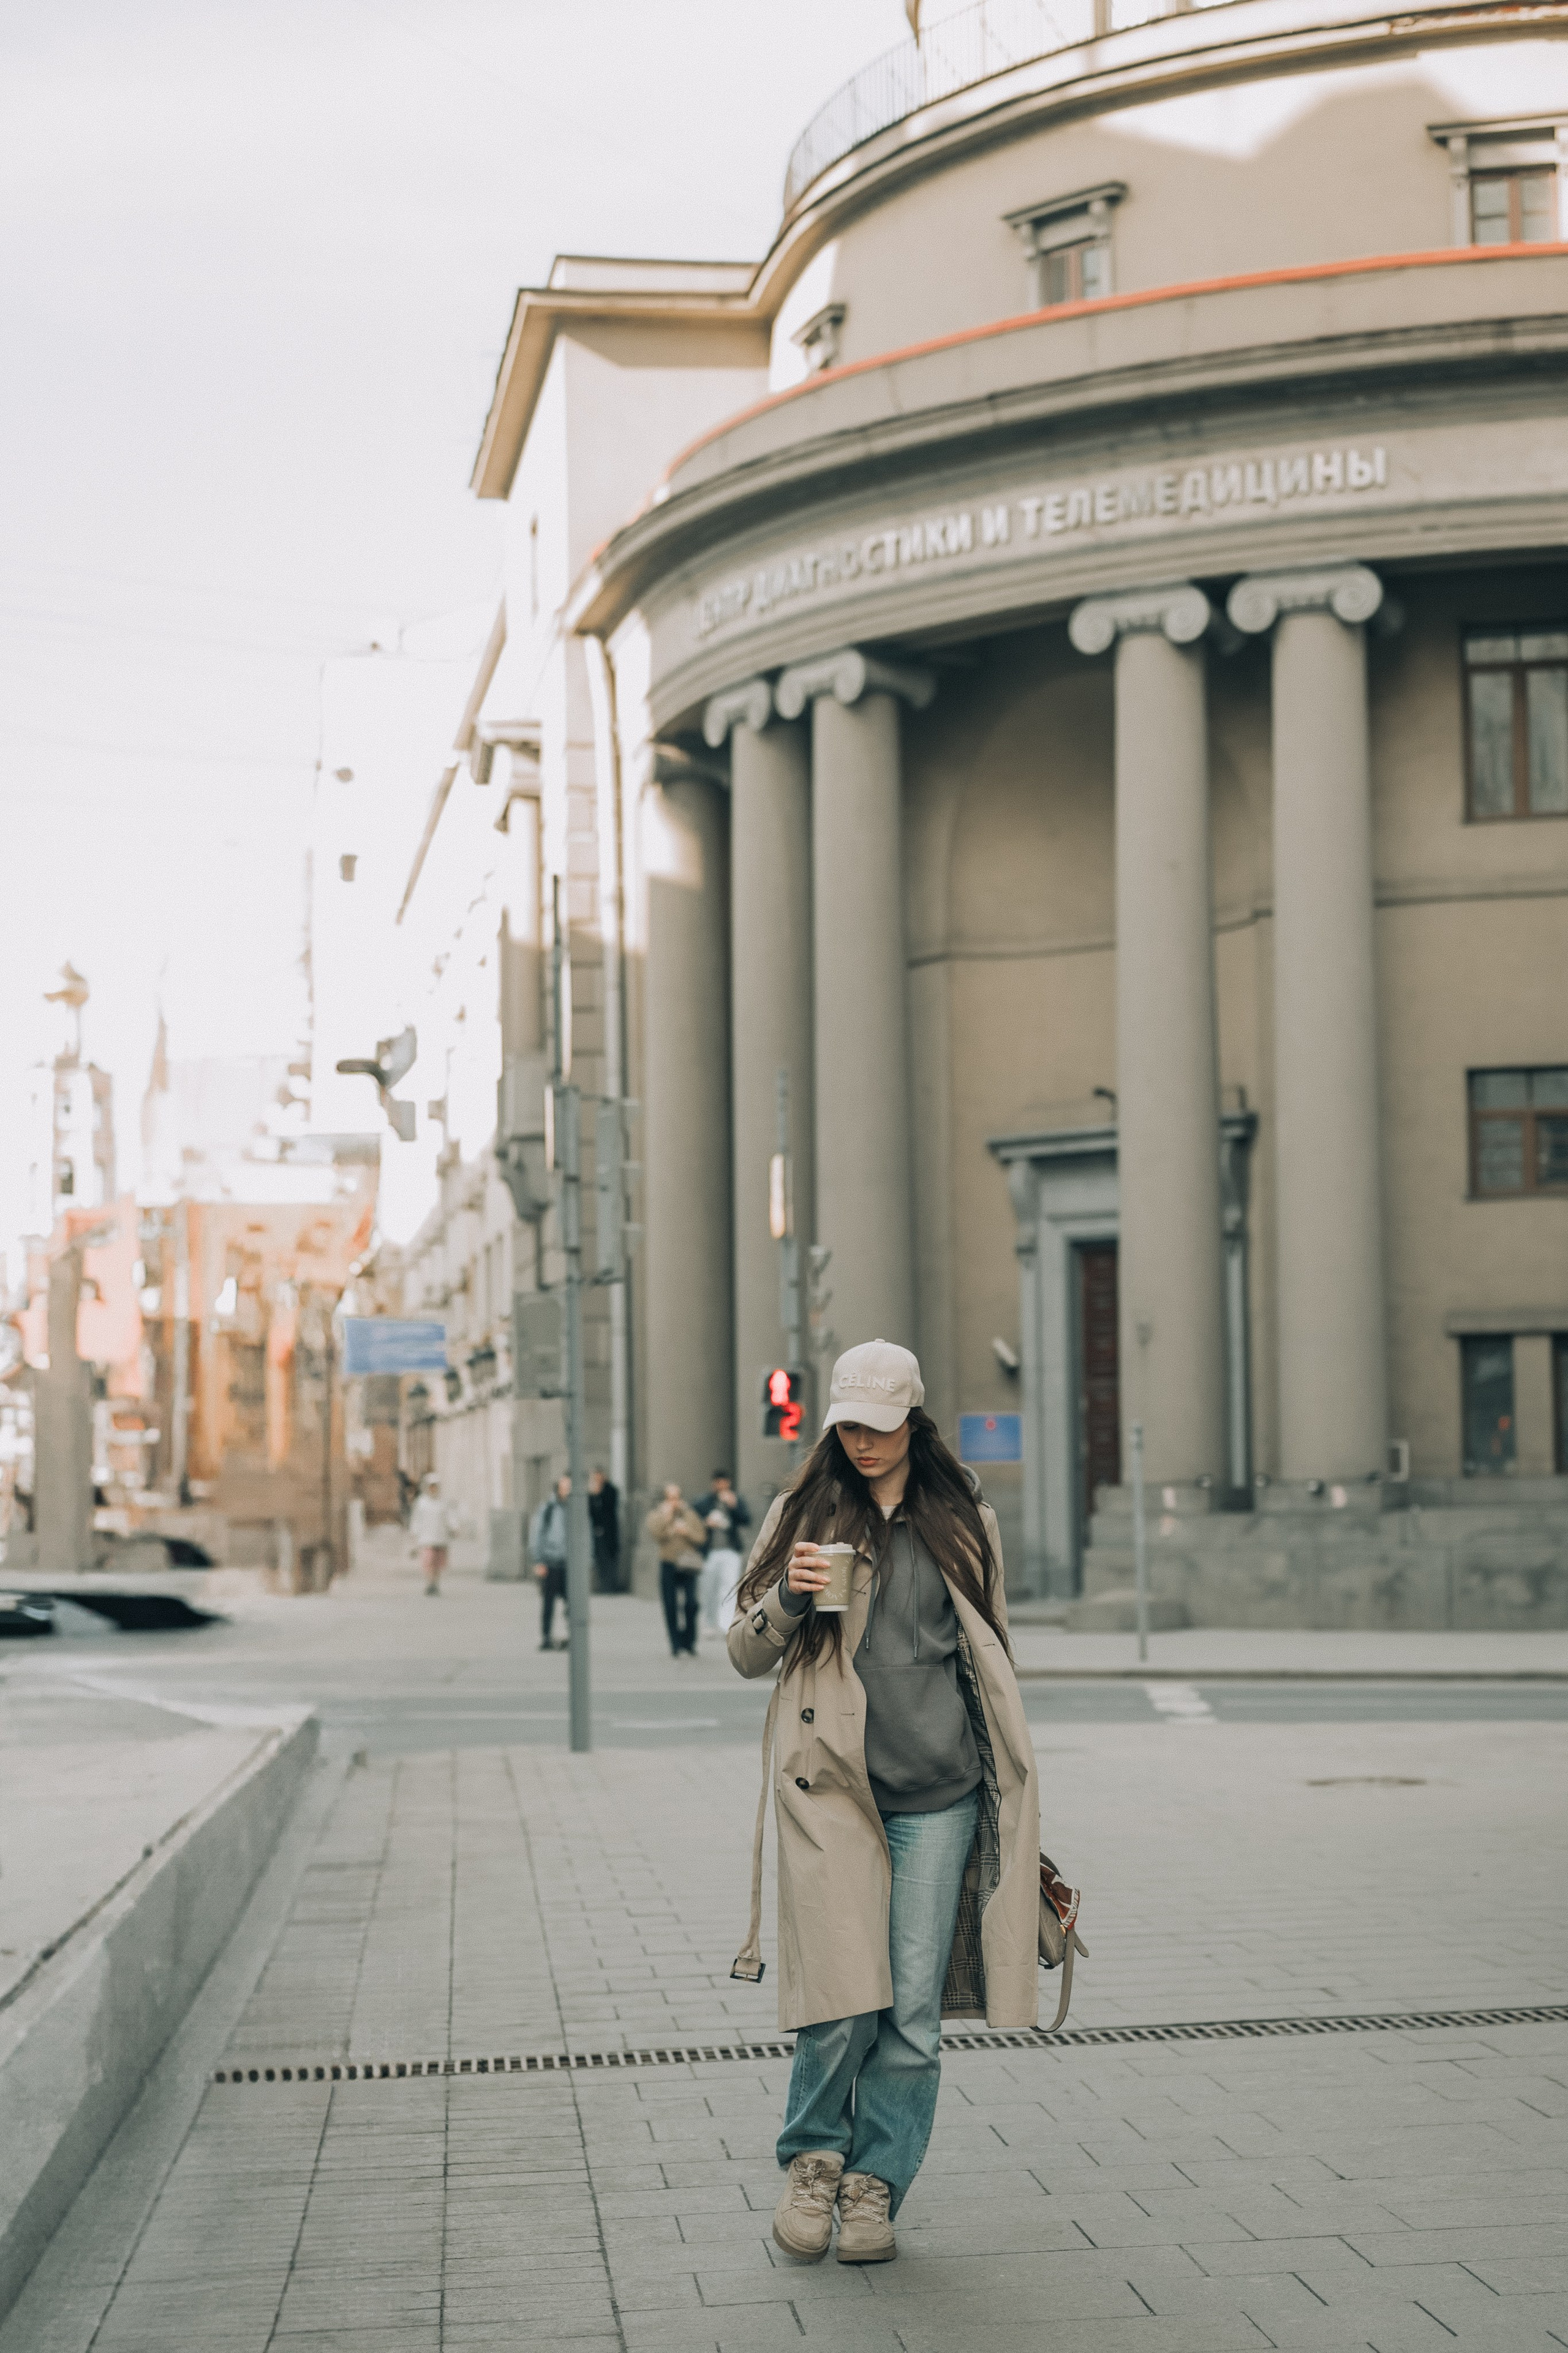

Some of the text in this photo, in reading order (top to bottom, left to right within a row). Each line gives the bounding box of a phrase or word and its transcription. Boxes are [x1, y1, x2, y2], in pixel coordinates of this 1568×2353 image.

[981, 504, 1012, 546] И
[1020, 447, 1386, 538] ТЕЛЕМЕДИЦИНЫ
[839, 1372, 895, 1394] CÉLINE
